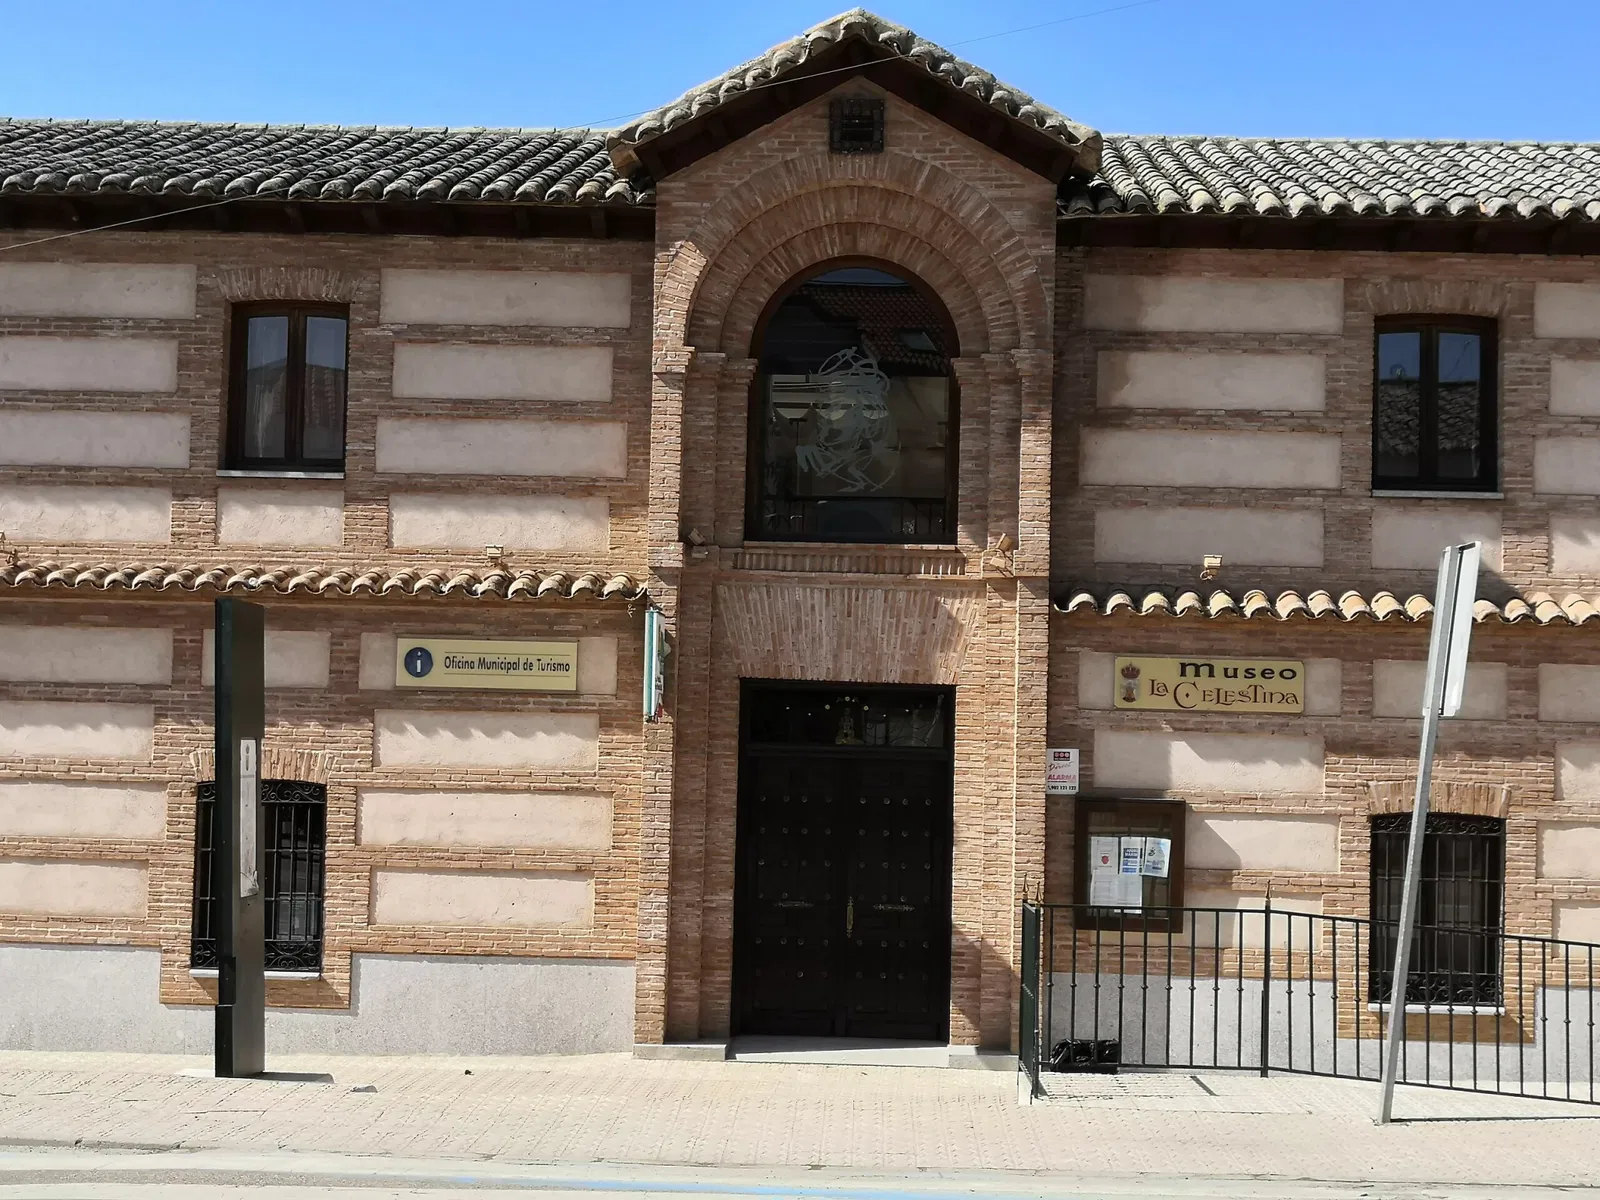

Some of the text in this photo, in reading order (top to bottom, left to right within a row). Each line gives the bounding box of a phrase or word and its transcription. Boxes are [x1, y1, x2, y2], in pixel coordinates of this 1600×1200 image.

[444, 656, 570, 674] Oficina Municipal de Turismo
